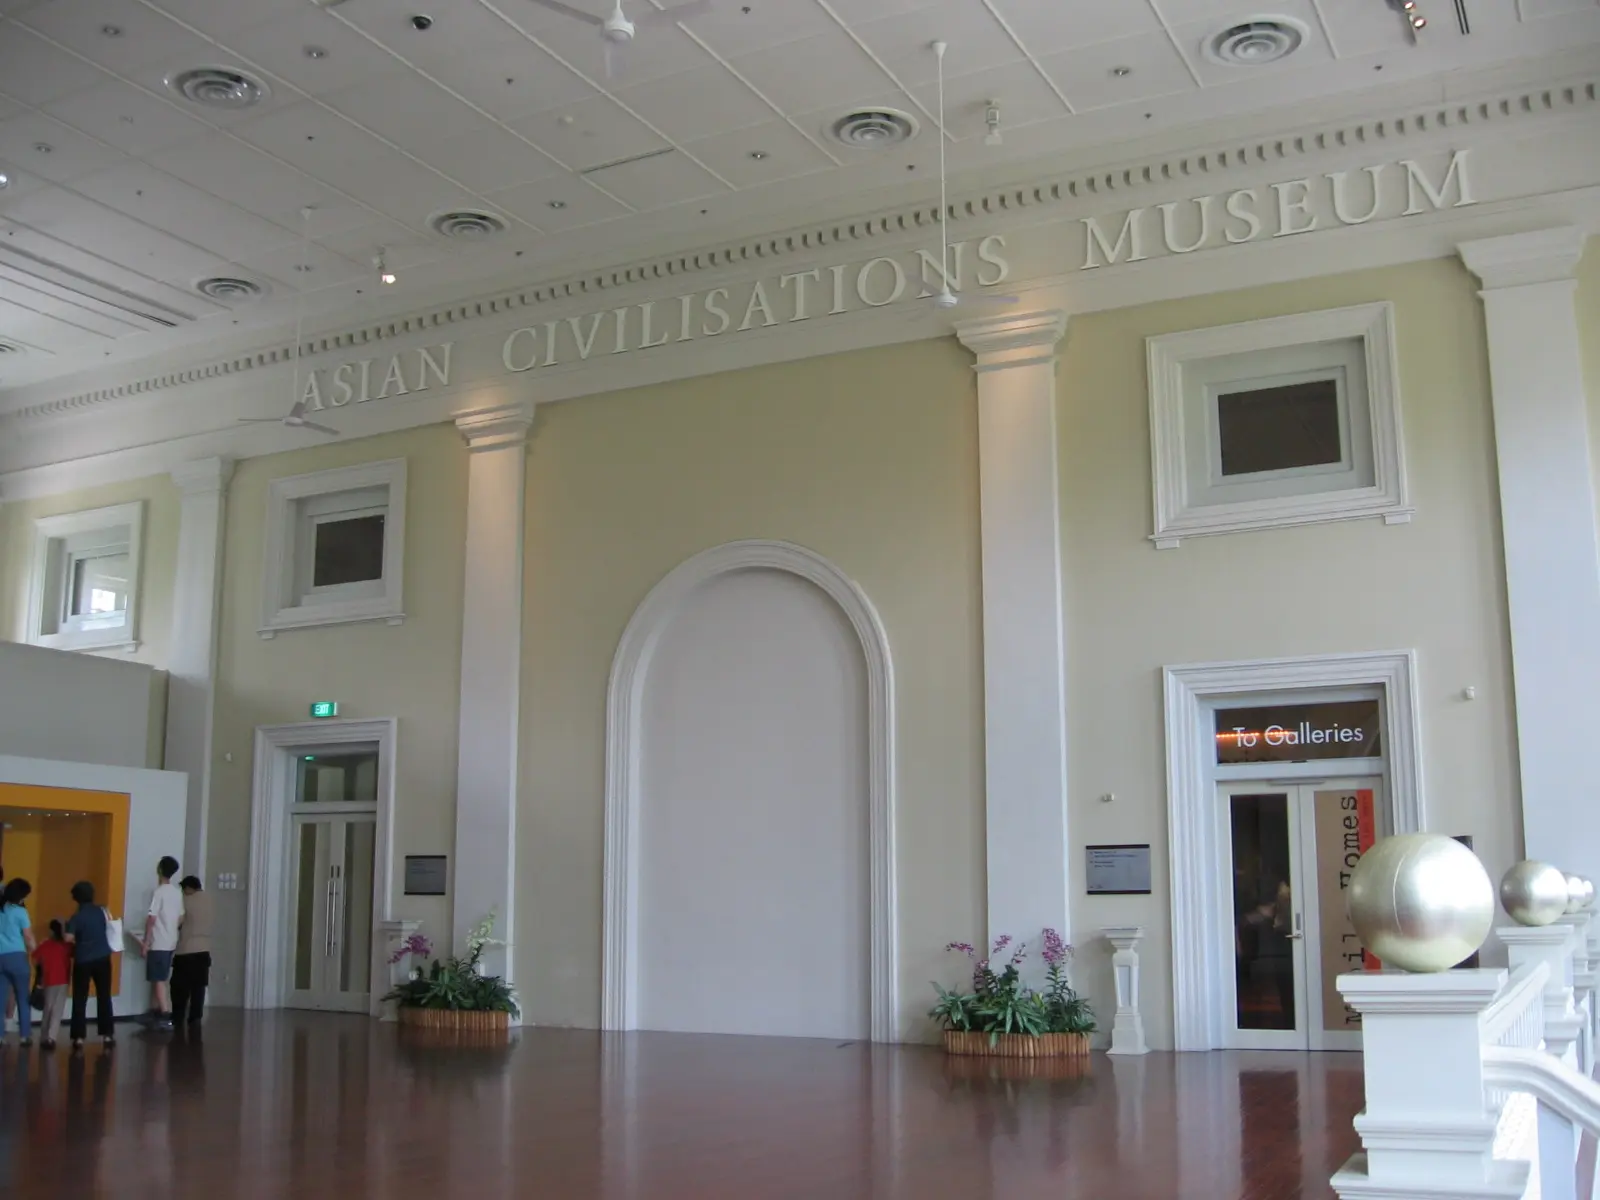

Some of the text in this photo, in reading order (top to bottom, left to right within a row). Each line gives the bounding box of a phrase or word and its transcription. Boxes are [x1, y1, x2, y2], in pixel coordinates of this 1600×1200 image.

[299, 148, 1479, 411] ASIAN CIVILISATIONS MUSEUM
[315, 703, 330, 715] EXIT
[1232, 721, 1363, 748] To Galleries
[1342, 912, 1365, 1025] Mil
